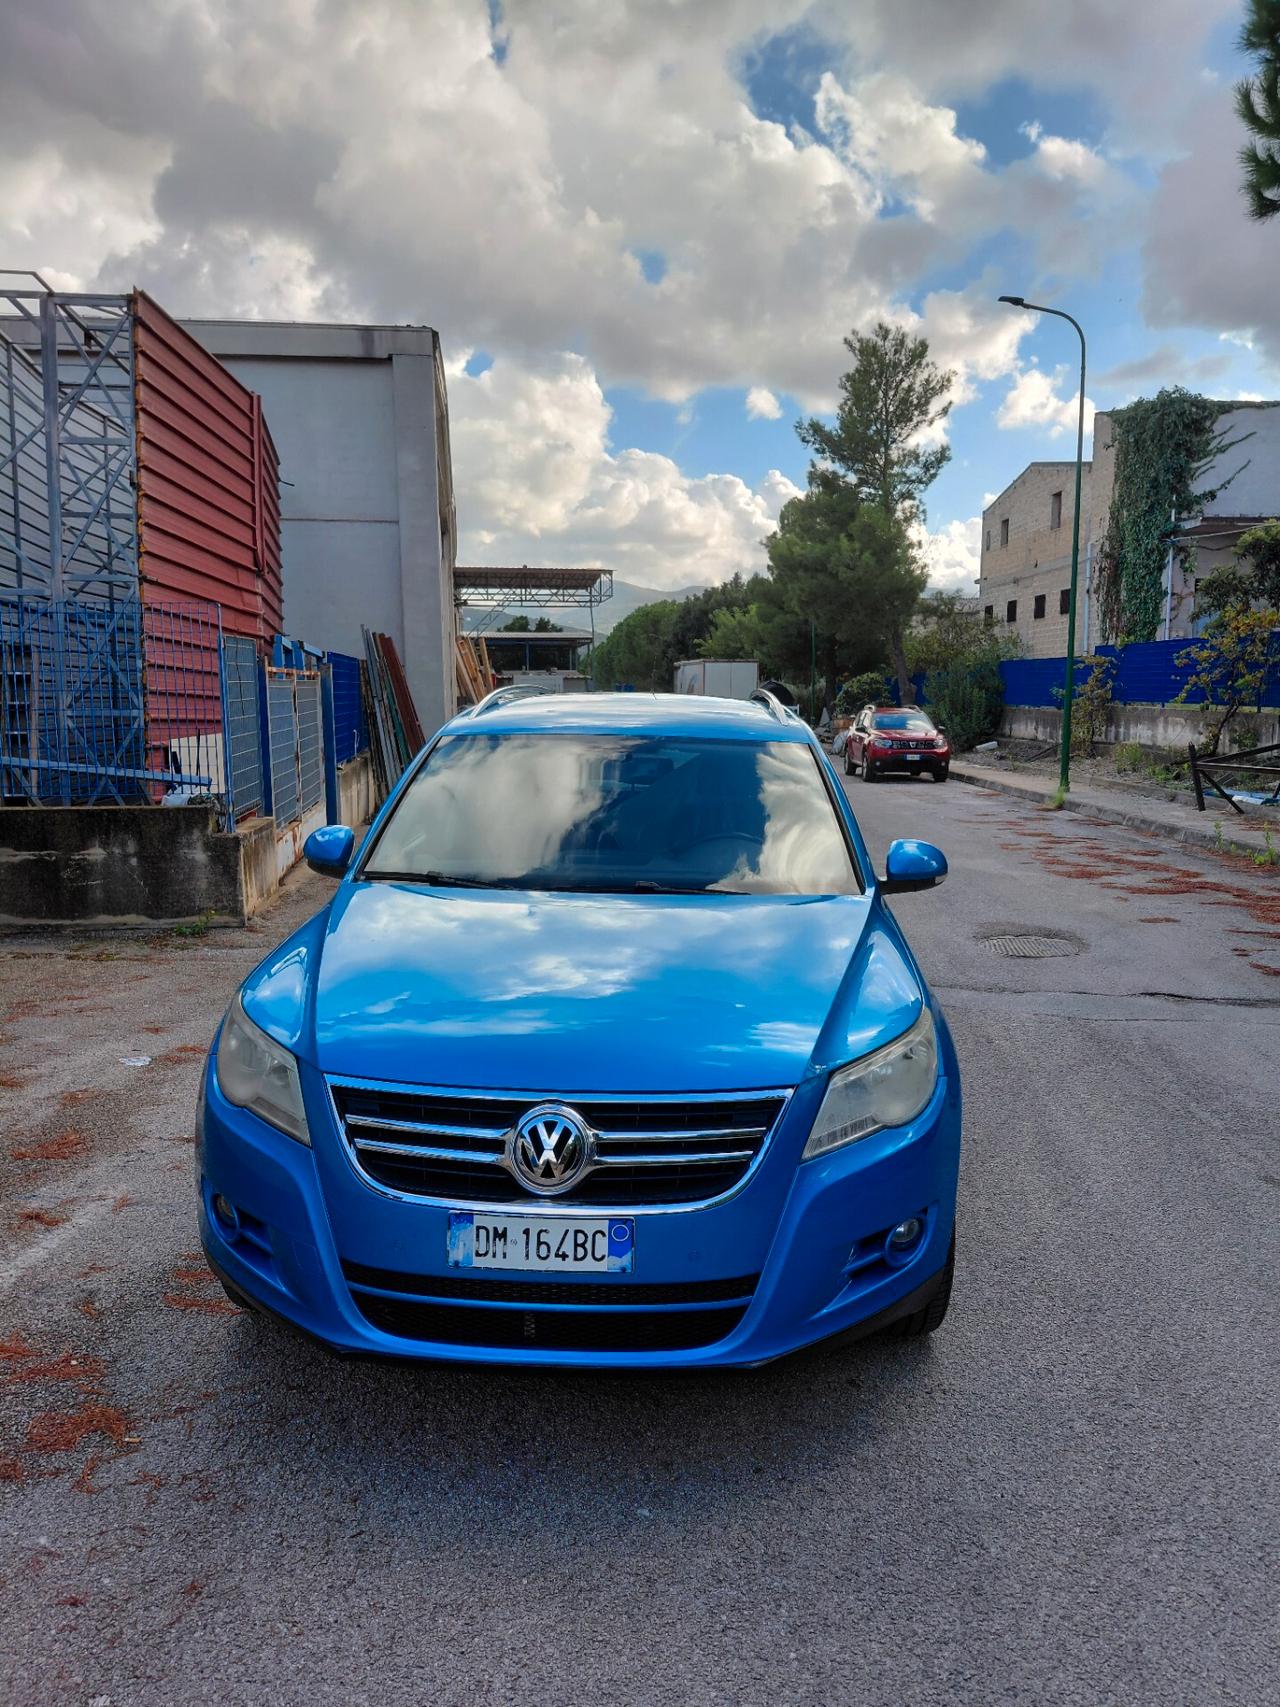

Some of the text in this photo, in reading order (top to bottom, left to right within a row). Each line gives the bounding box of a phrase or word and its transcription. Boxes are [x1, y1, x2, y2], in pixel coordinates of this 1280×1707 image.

[515, 1114, 582, 1185] VW
[474, 1225, 607, 1262] DM 164BC
